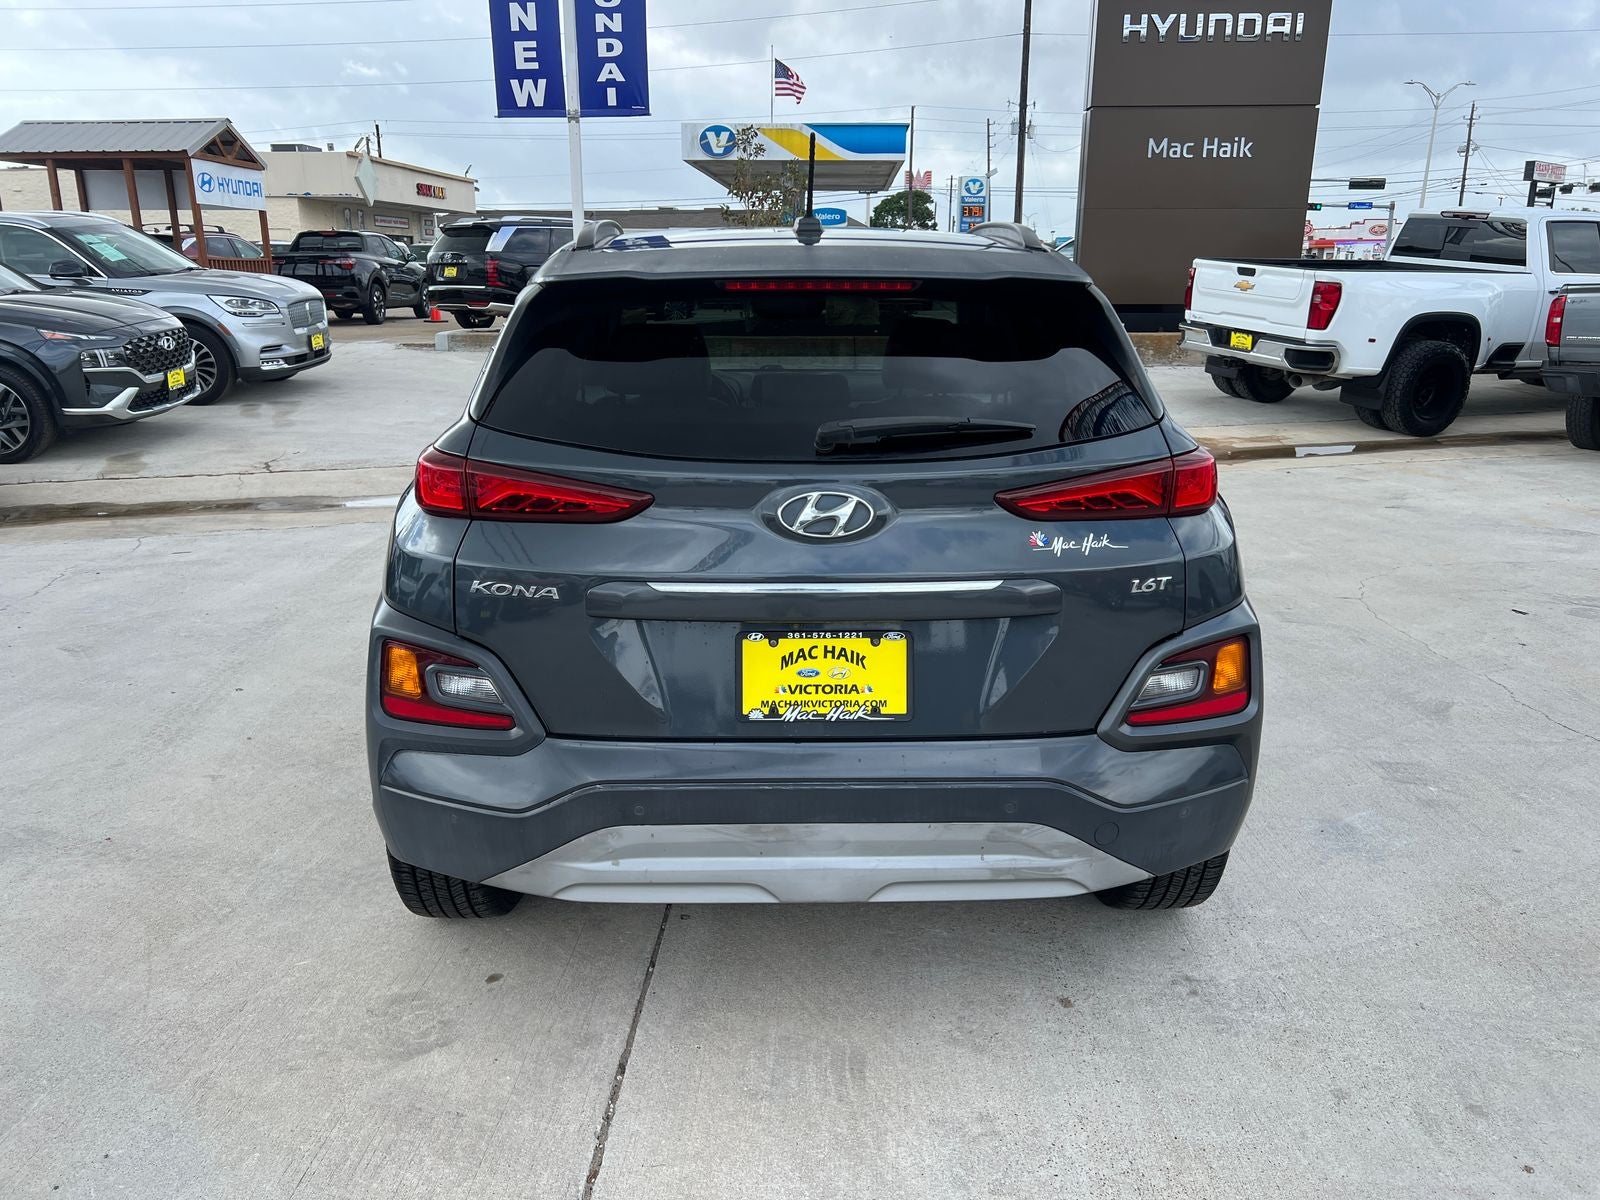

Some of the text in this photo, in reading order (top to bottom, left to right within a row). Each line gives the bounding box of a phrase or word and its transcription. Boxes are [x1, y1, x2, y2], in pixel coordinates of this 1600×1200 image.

[1121, 12, 1305, 43] HYUNDAI
[508, 1, 547, 108] NEW
[1147, 137, 1254, 159] Mac Haik
[216, 176, 263, 198] HYUNDAI
[1050, 532, 1115, 557] Mac Haik
[469, 580, 560, 600] KONA
[780, 645, 867, 671] MAC HAIK
[787, 684, 860, 695] VICTORIA
[760, 699, 888, 708] MACHAIKVICTORIACOM
[780, 704, 874, 722] Mac Haik
